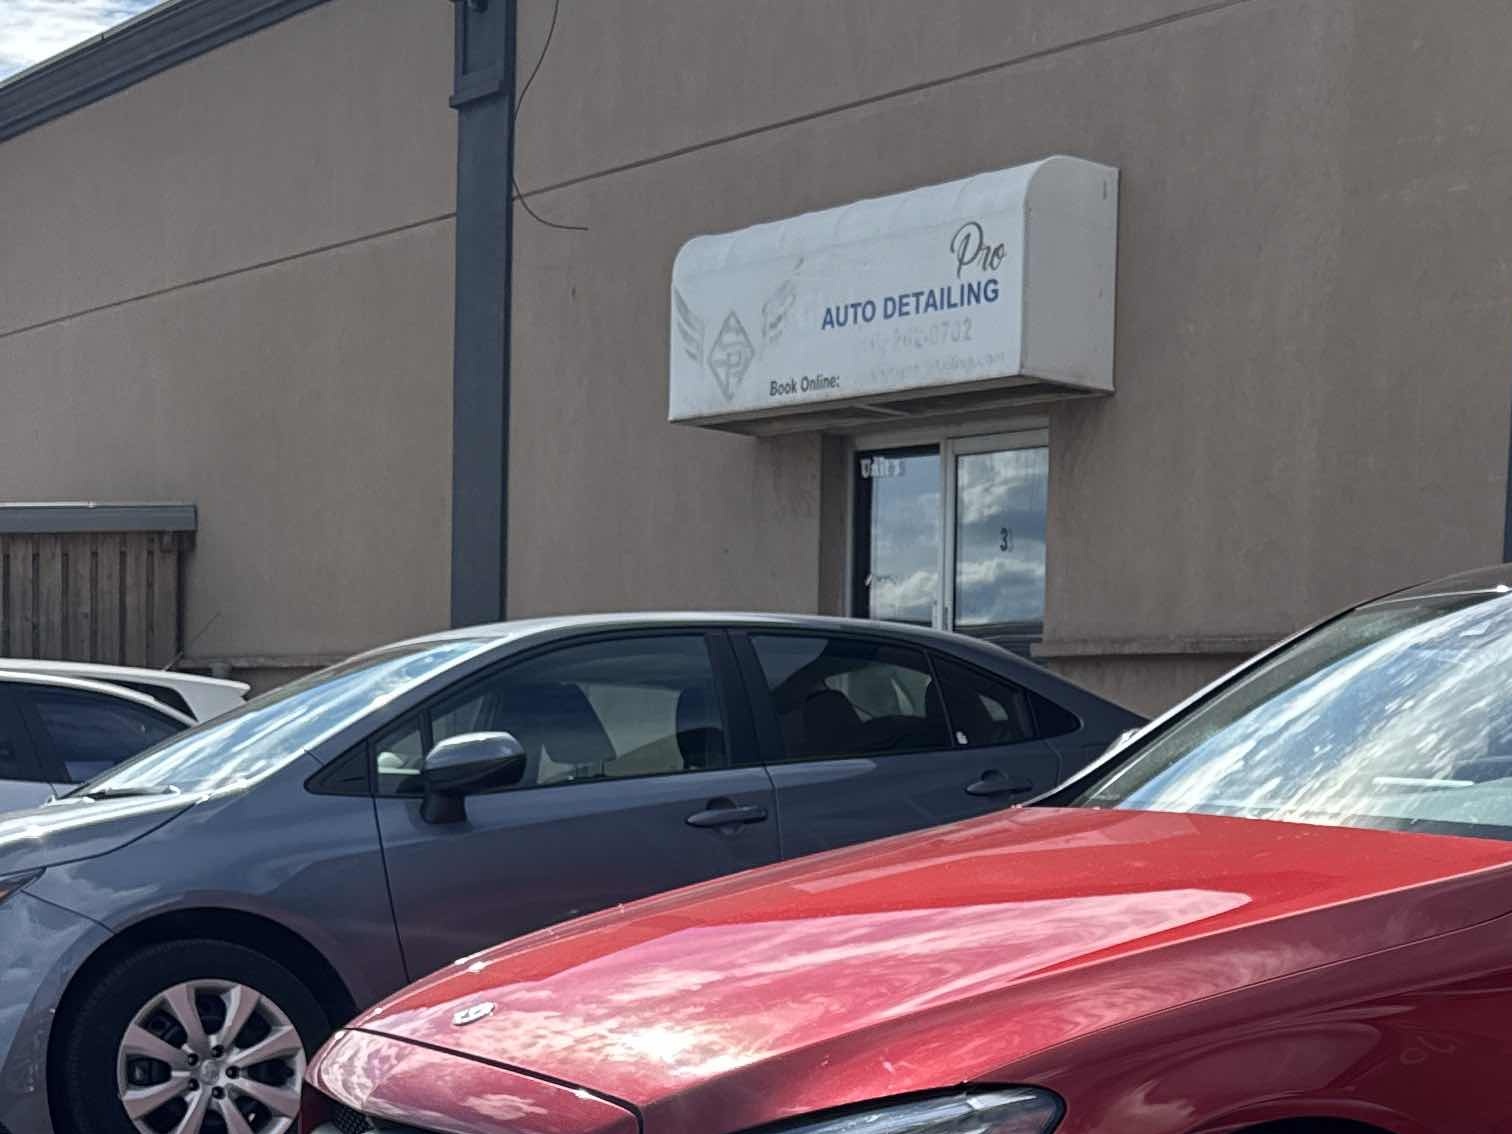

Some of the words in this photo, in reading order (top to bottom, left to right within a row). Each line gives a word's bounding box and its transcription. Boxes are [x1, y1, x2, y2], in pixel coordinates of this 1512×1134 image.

[950, 221, 1006, 279] Pro
[821, 299, 876, 330] AUTO
[883, 279, 999, 318] DETAILING
[769, 378, 798, 397] Book
[800, 373, 840, 393] Online:
[1000, 527, 1009, 551] 3
